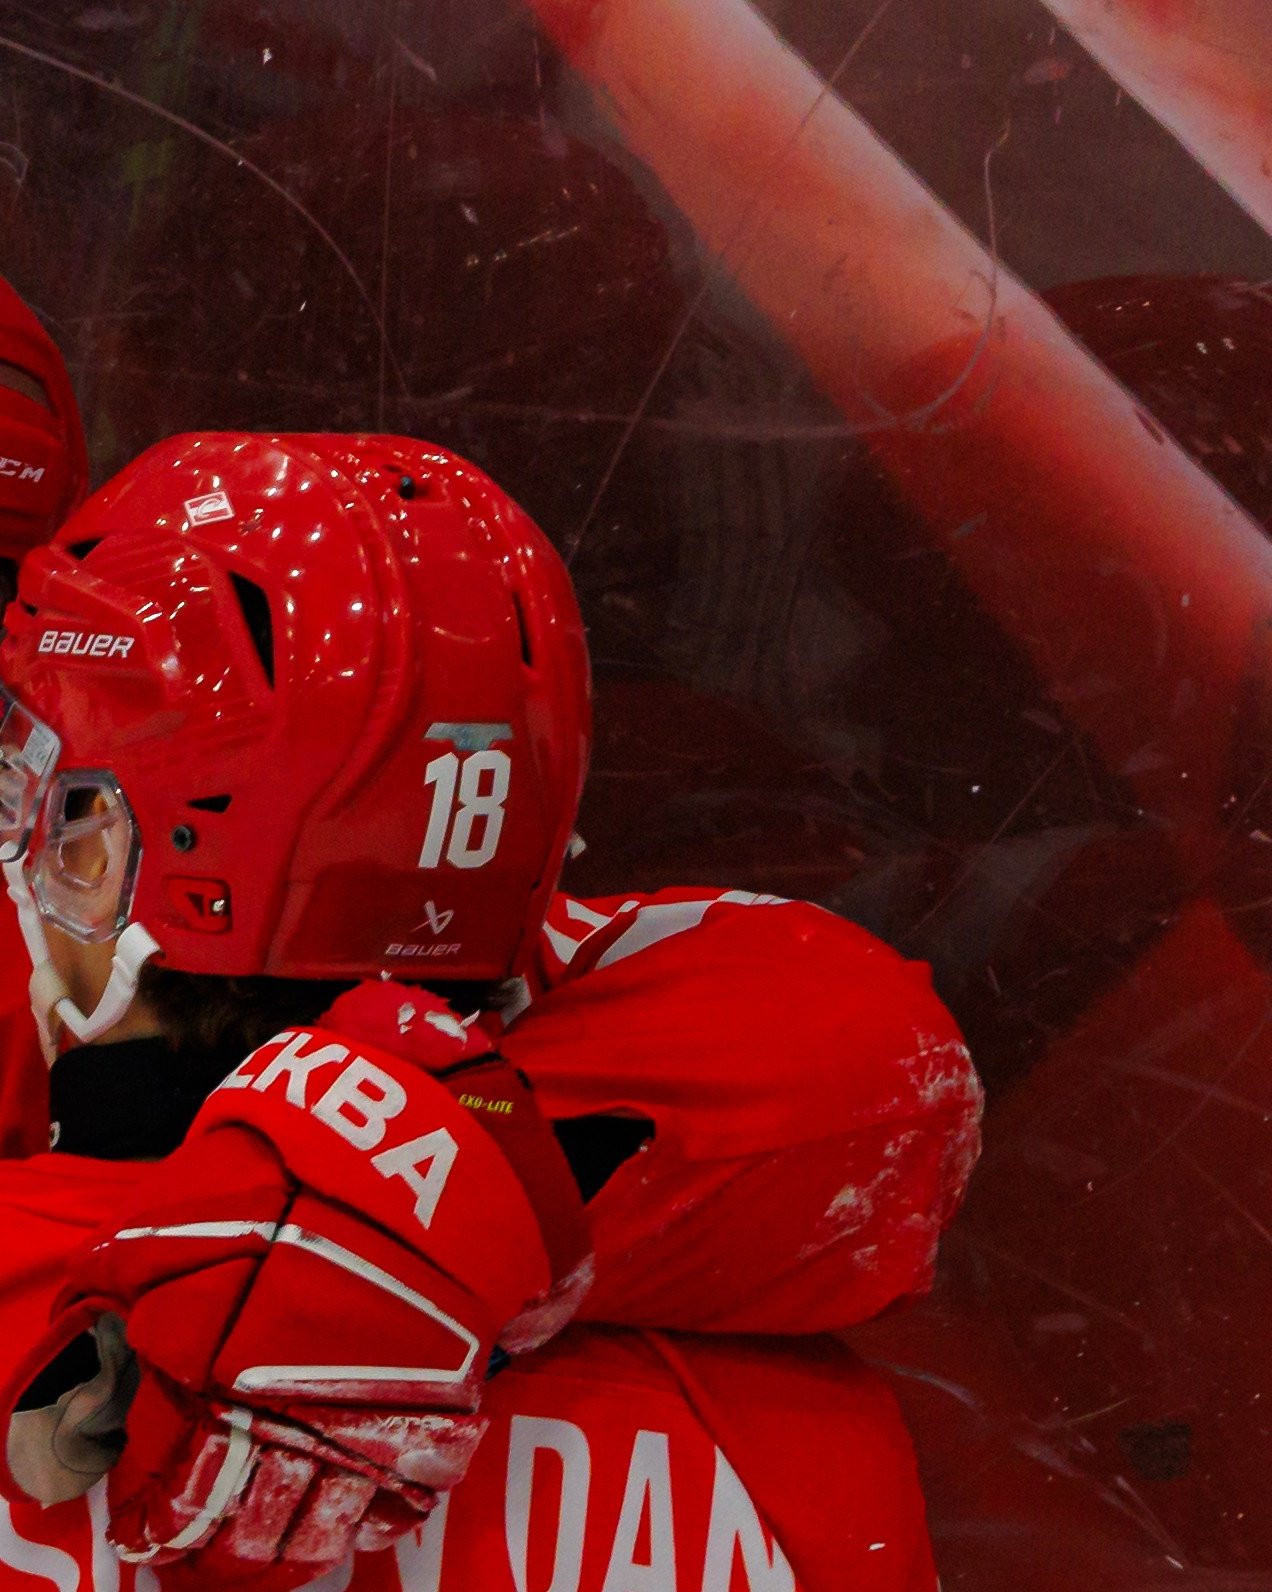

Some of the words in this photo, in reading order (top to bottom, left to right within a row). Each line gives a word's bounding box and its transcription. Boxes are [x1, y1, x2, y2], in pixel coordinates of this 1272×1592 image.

[37, 629, 135, 659] BAUER
[418, 749, 512, 869] 18
[384, 943, 463, 956] BAUER
[458, 1093, 514, 1115] EXO-LITE
